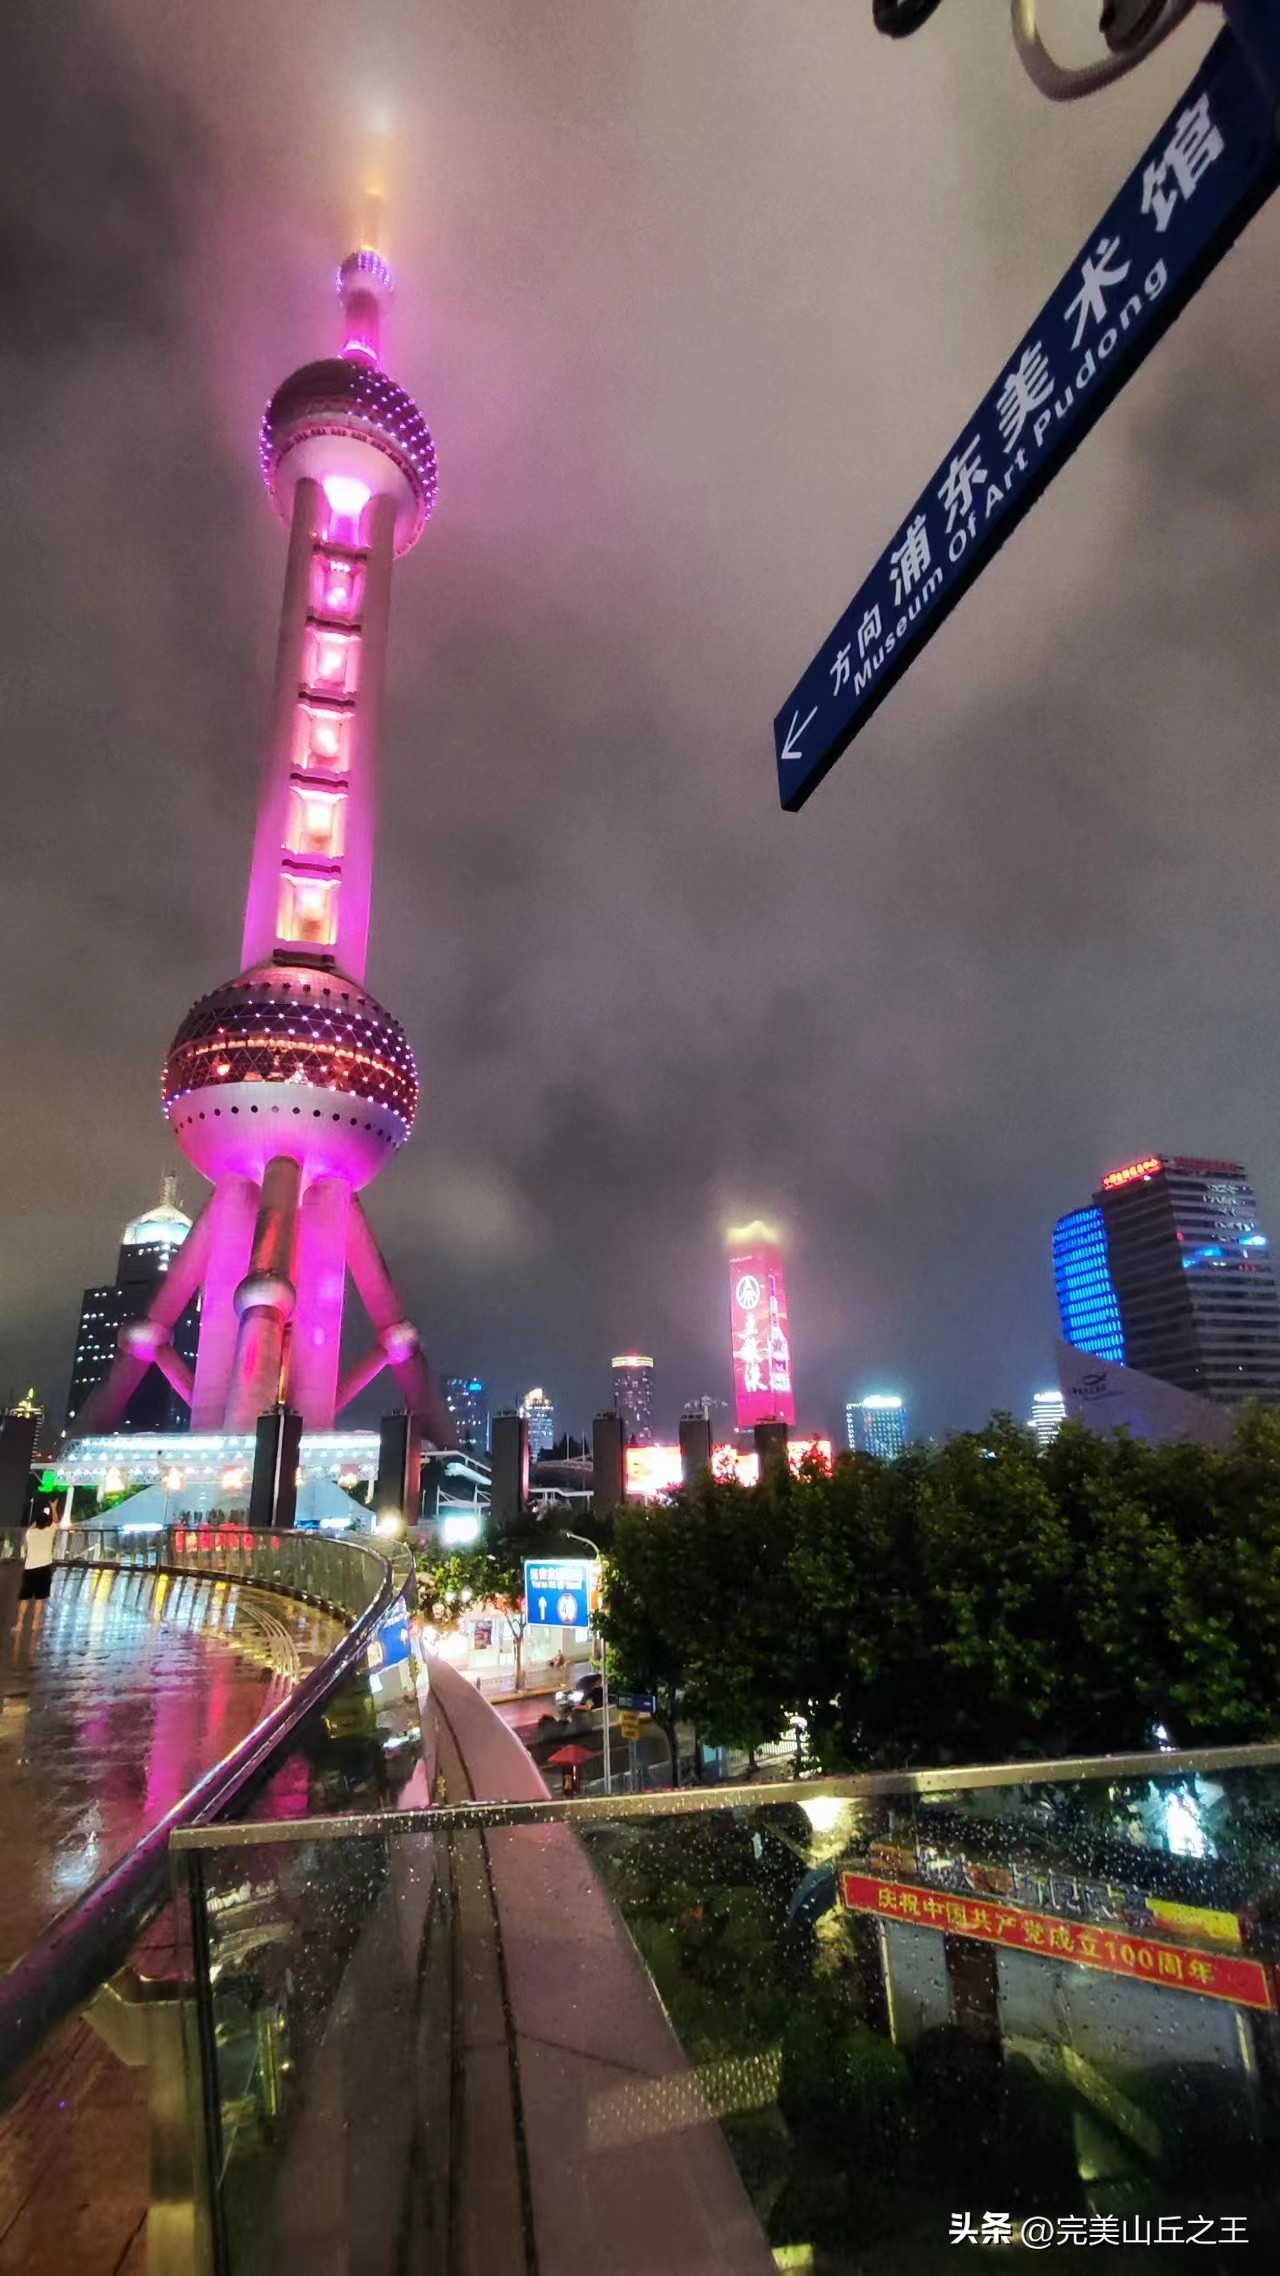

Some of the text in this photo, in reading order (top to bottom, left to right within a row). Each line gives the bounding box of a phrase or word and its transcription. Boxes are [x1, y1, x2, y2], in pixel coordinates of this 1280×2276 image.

[829, 92, 1225, 697] 方向 浦东美术馆
[853, 257, 1168, 696] Museum Of Art Pudong
[876, 1885, 1216, 1985] 庆祝中国共产党成立100周年
